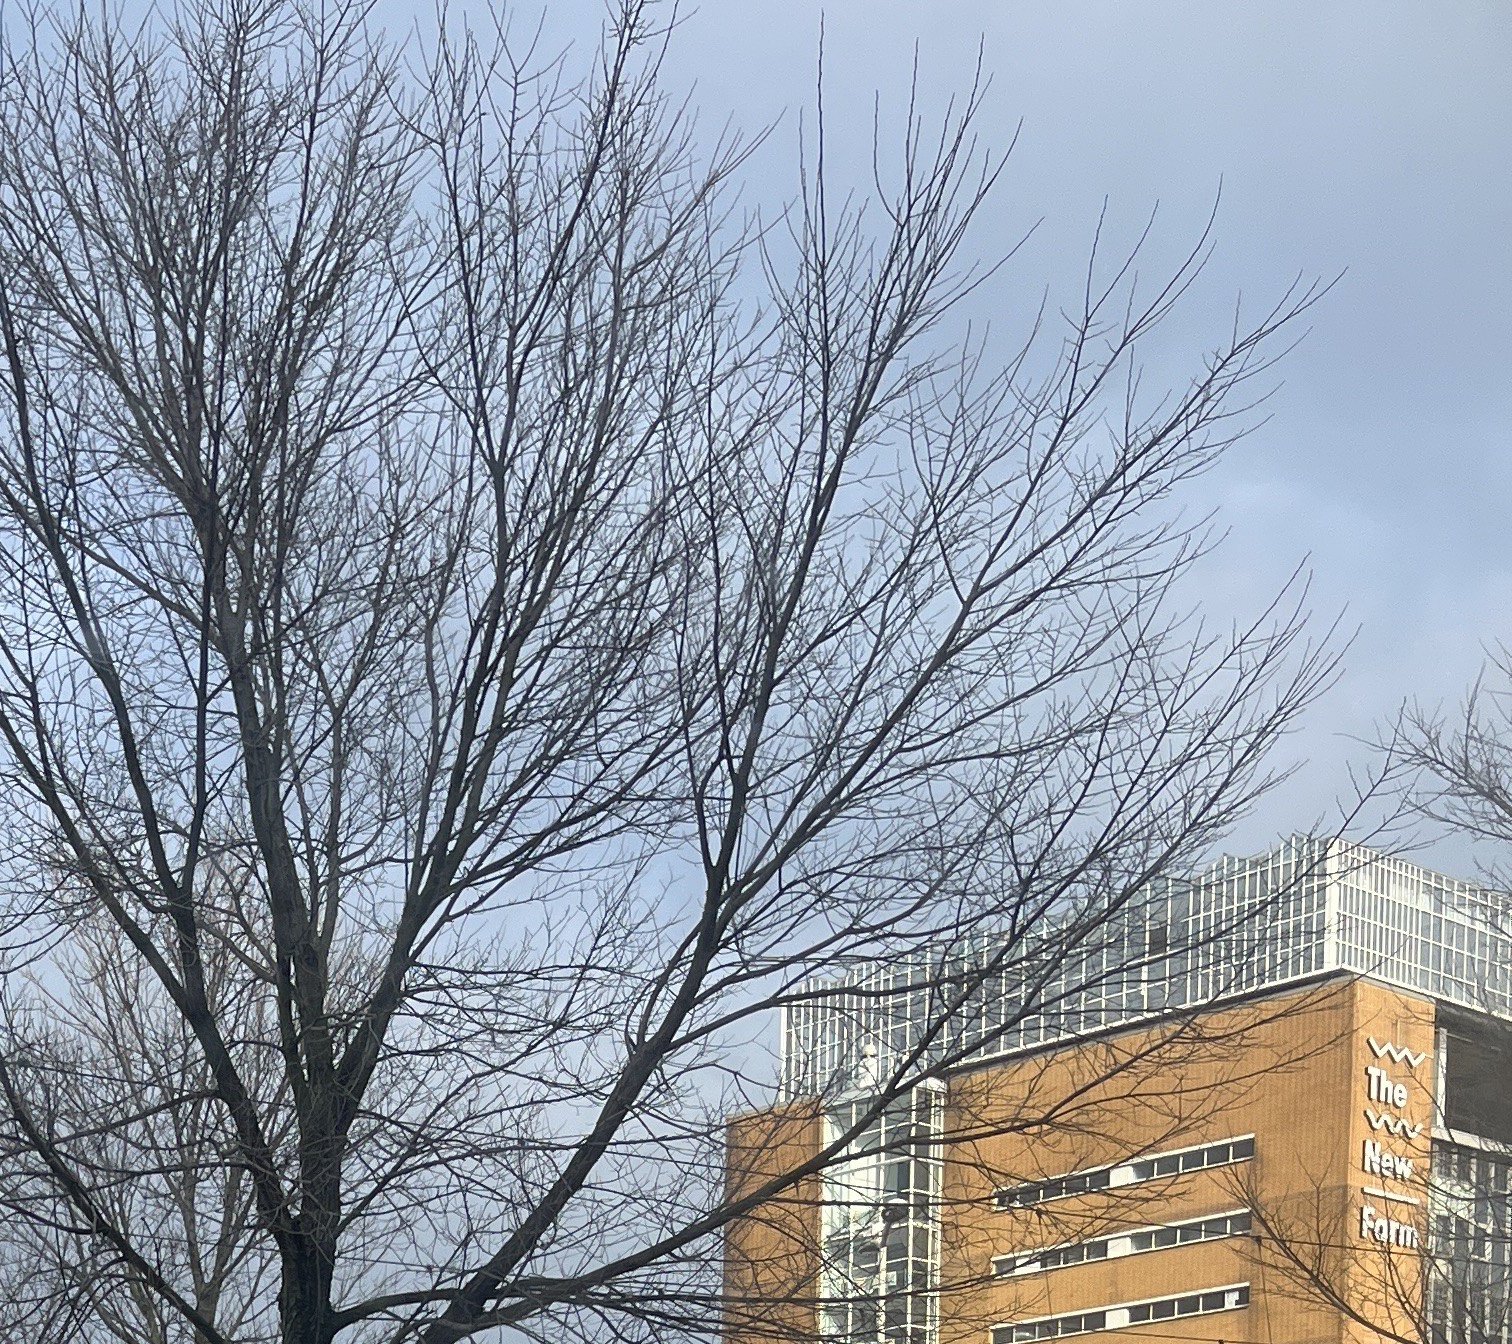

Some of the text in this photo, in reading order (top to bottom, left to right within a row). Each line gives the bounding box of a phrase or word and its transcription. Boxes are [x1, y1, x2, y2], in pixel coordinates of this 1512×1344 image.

[1365, 1065, 1407, 1109] The
[1362, 1138, 1413, 1181] New
[1360, 1205, 1418, 1249] Farm
